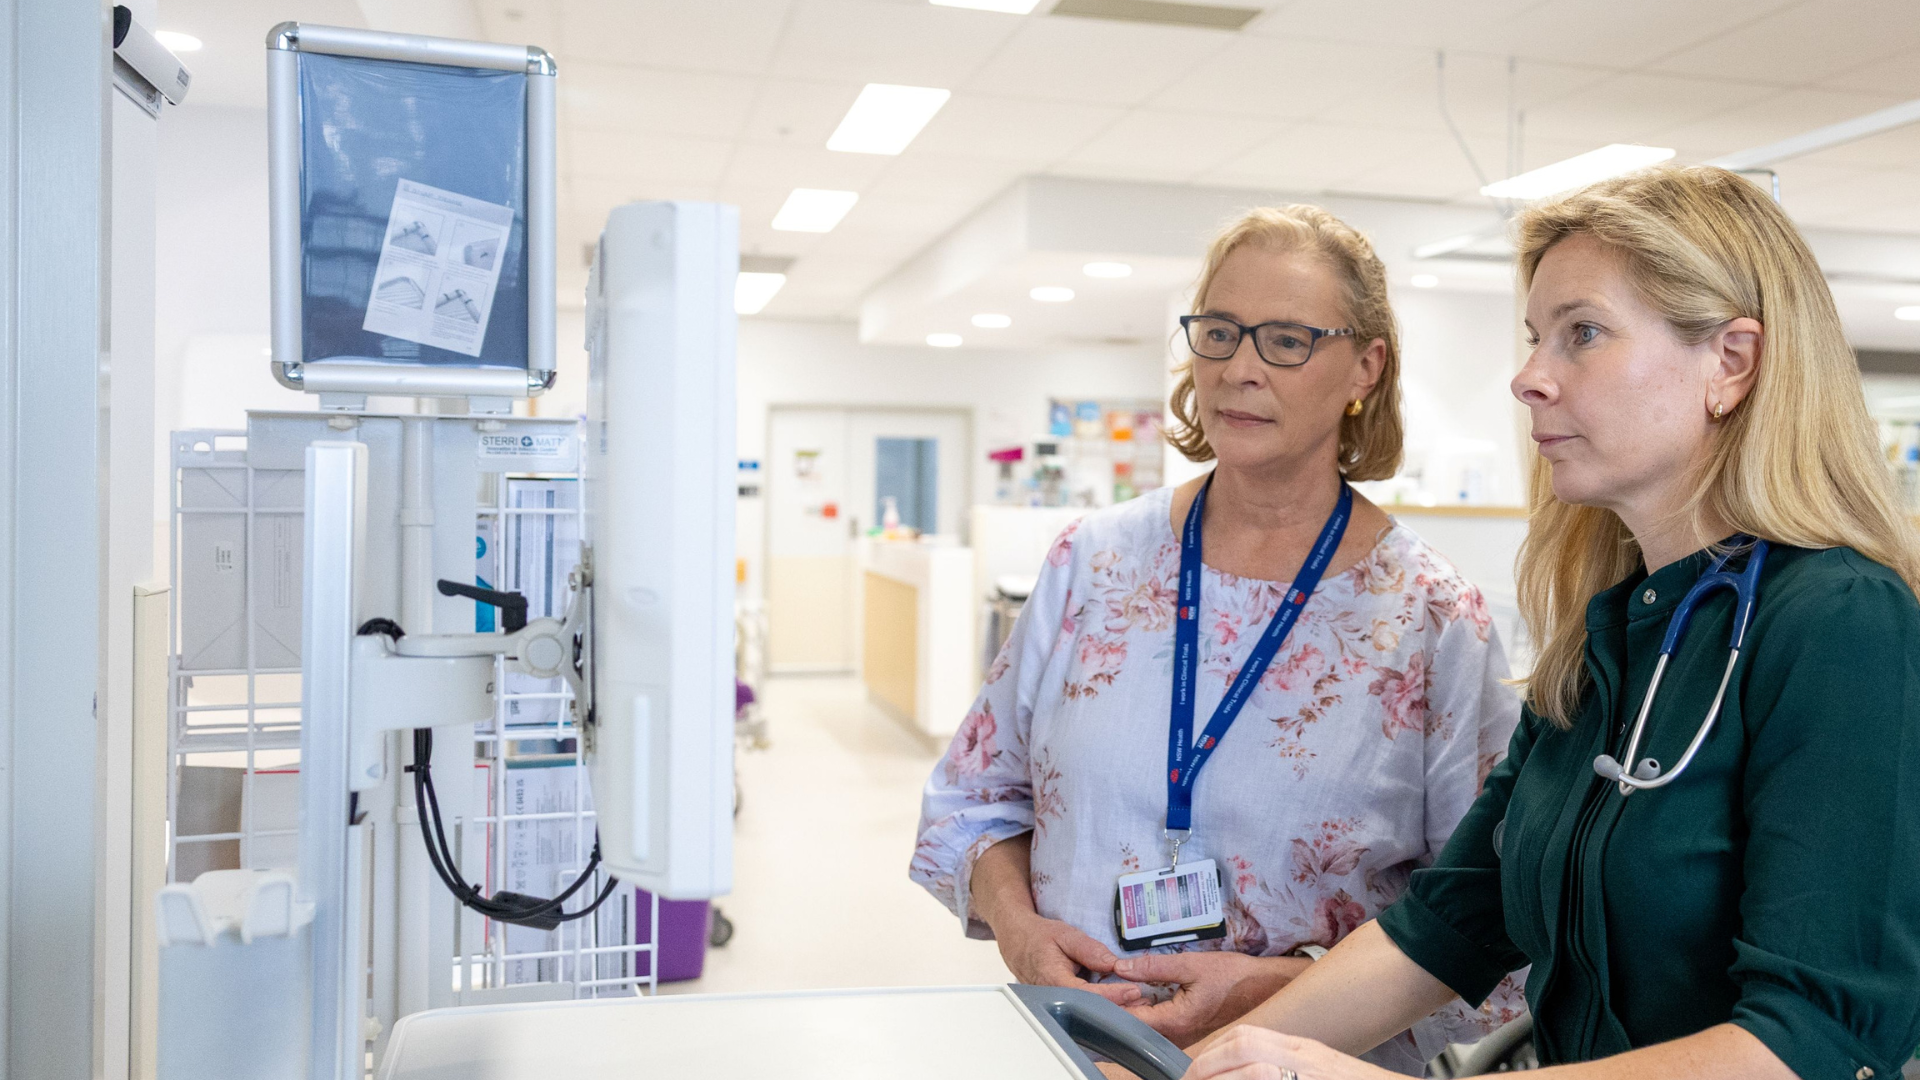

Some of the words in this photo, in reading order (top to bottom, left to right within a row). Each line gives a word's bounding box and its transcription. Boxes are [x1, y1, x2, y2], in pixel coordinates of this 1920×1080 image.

[482, 436, 517, 446] STERRI
[1319, 535, 1333, 555] Clinical
[1311, 554, 1323, 570] Trials
[1281, 609, 1292, 622] NSW
[1271, 620, 1285, 637] Health
[1249, 660, 1260, 673] work
[1233, 679, 1249, 699] Clinical
[1222, 699, 1237, 714] Trials
[1175, 747, 1183, 762] NSW
[1190, 754, 1201, 768] NSW
[1181, 767, 1193, 787] Health
